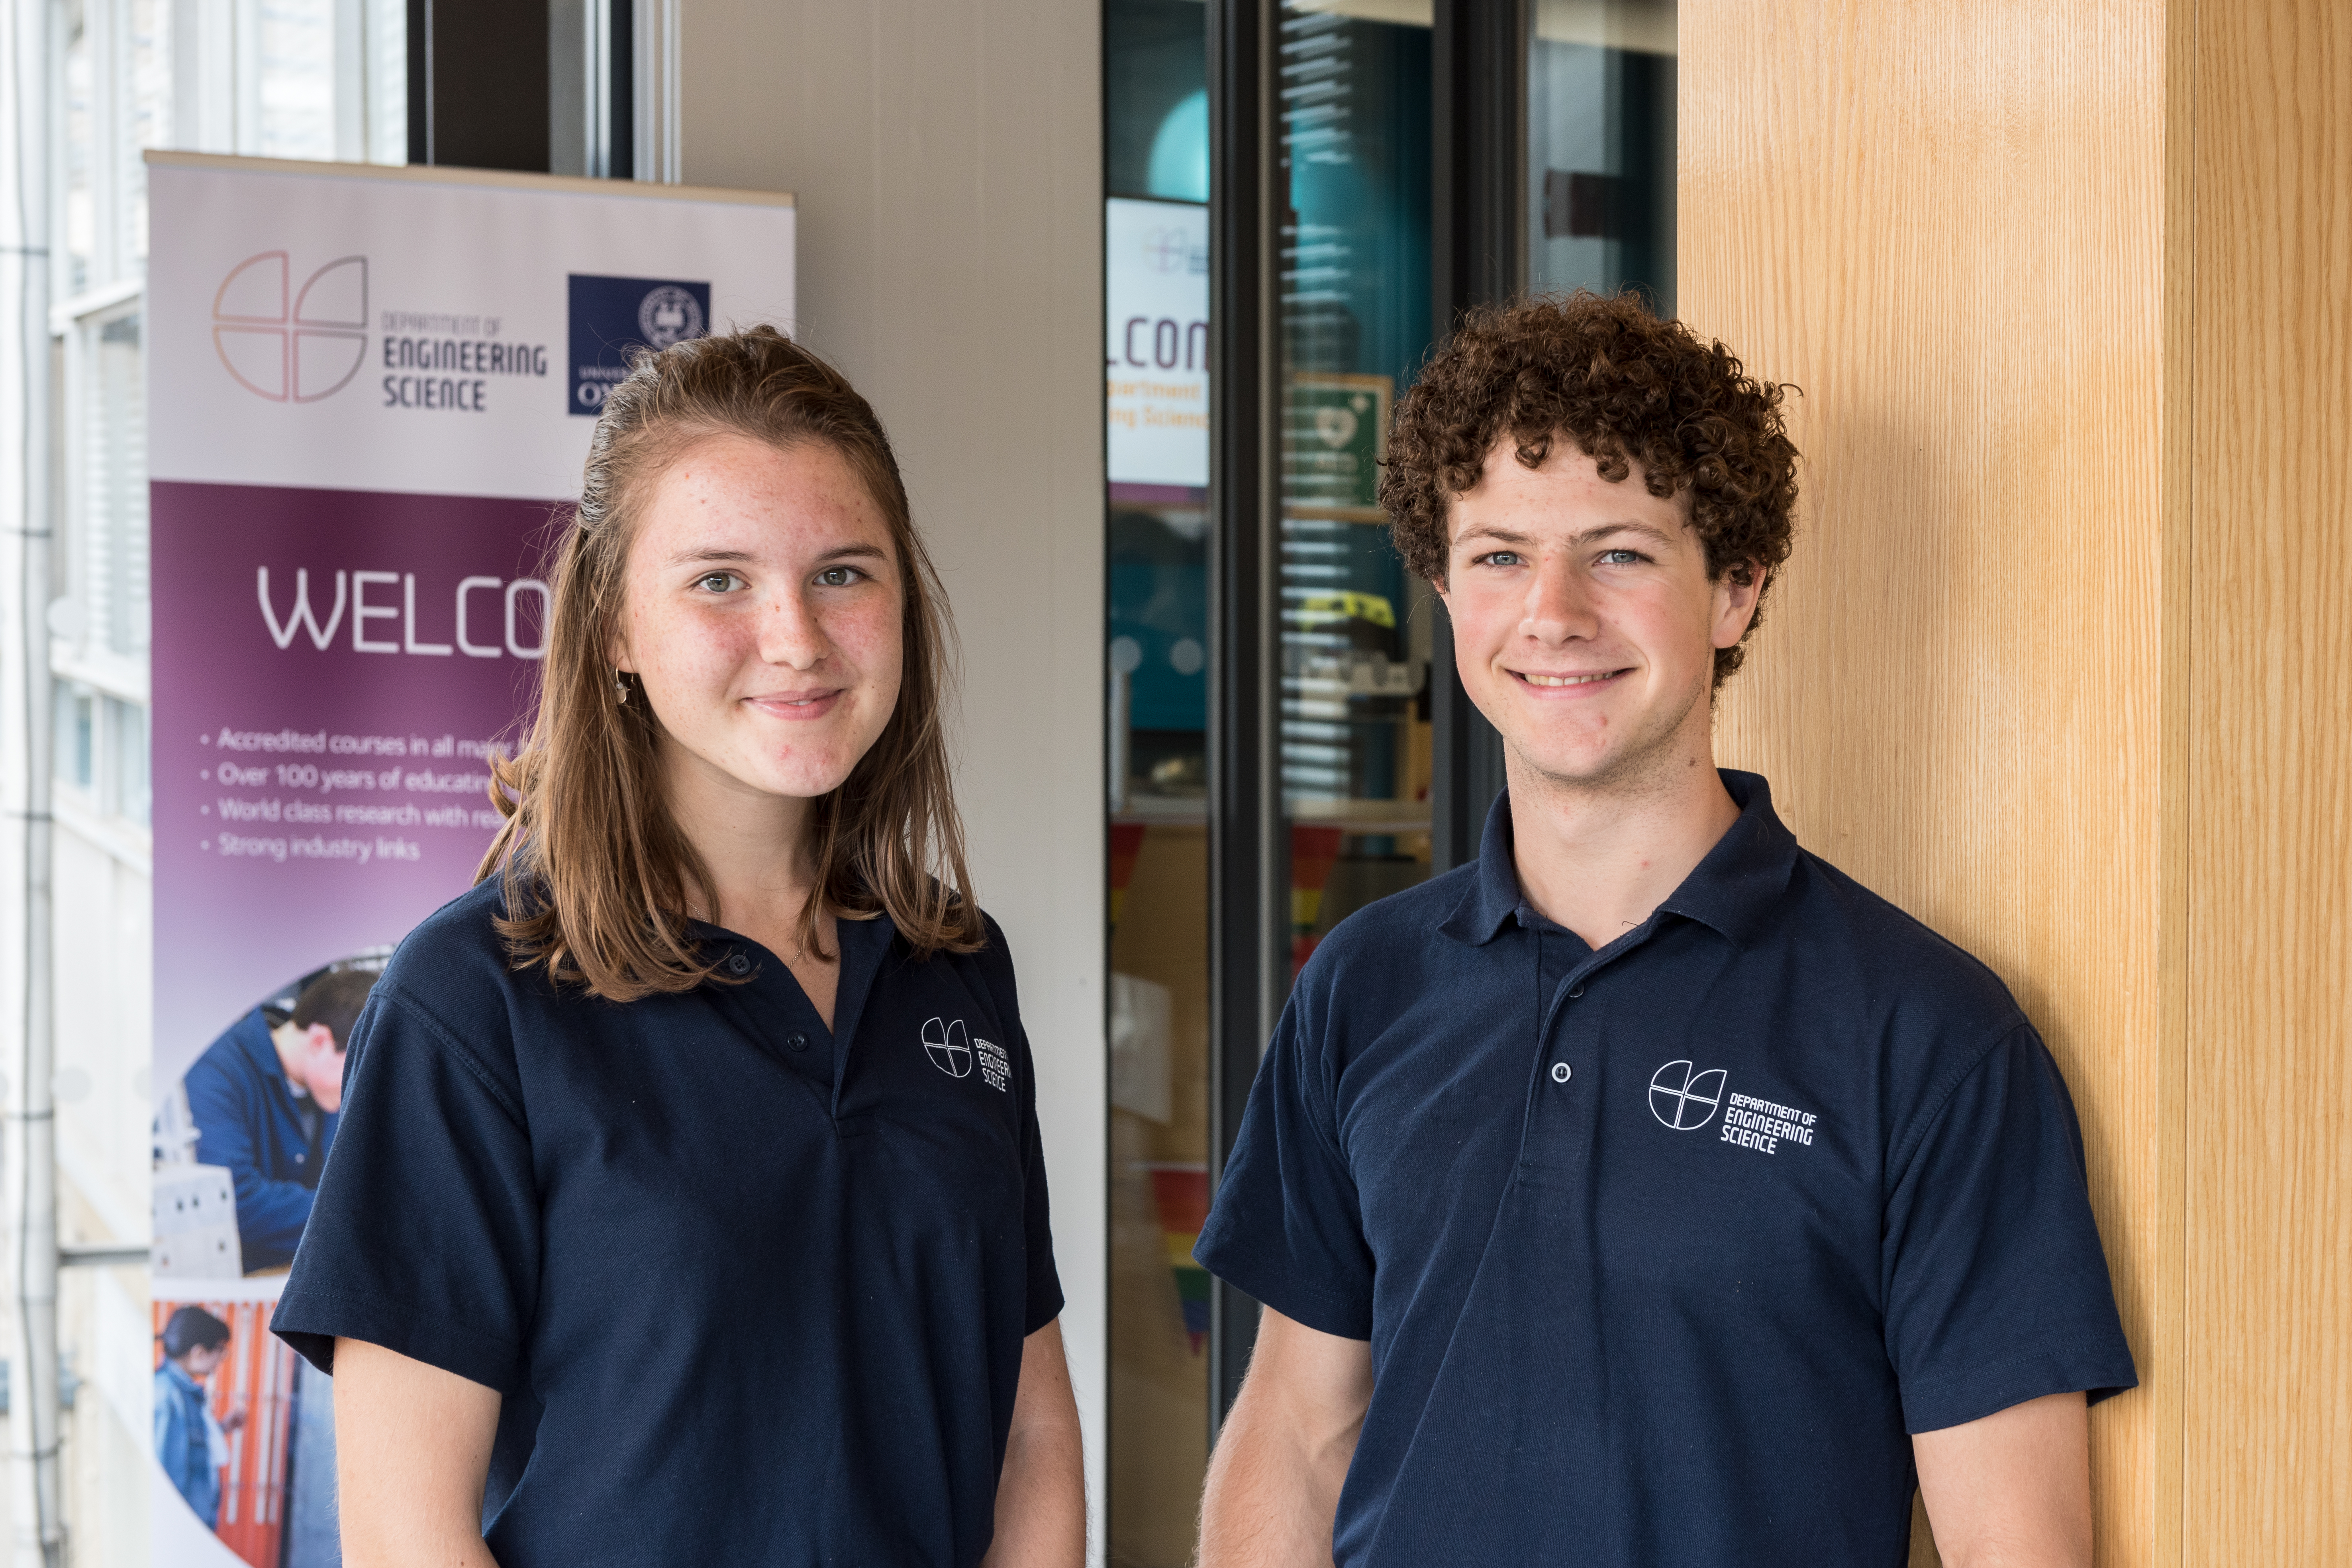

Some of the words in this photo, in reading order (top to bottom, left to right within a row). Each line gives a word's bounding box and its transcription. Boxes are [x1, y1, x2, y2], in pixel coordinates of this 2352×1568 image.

[381, 310, 480, 335] DEPARTMENT
[484, 316, 501, 337] OF
[383, 336, 548, 377] ENGINEERING
[382, 374, 486, 413] SCIENCE
[217, 727, 326, 754] Accredited
[329, 735, 406, 755] courses
[409, 733, 429, 757] in
[431, 735, 454, 758] all
[218, 761, 271, 786] Over
[275, 764, 319, 788] 100
[321, 769, 376, 793] years
[378, 766, 404, 791] of
[404, 768, 491, 794] educatin
[218, 797, 280, 822] World
[282, 800, 333, 824] class
[335, 802, 420, 827] research
[423, 805, 469, 828] with
[218, 832, 288, 863] Strong
[289, 834, 372, 864] industry
[376, 837, 421, 862] links
[982, 1067, 1006, 1092] SCIENCE
[1729, 1092, 1801, 1122] DEPARTMENT
[1801, 1112, 1817, 1126] OF
[1720, 1125, 1778, 1154] SCIENCE
[1725, 1106, 1813, 1146] ENGINEERING
